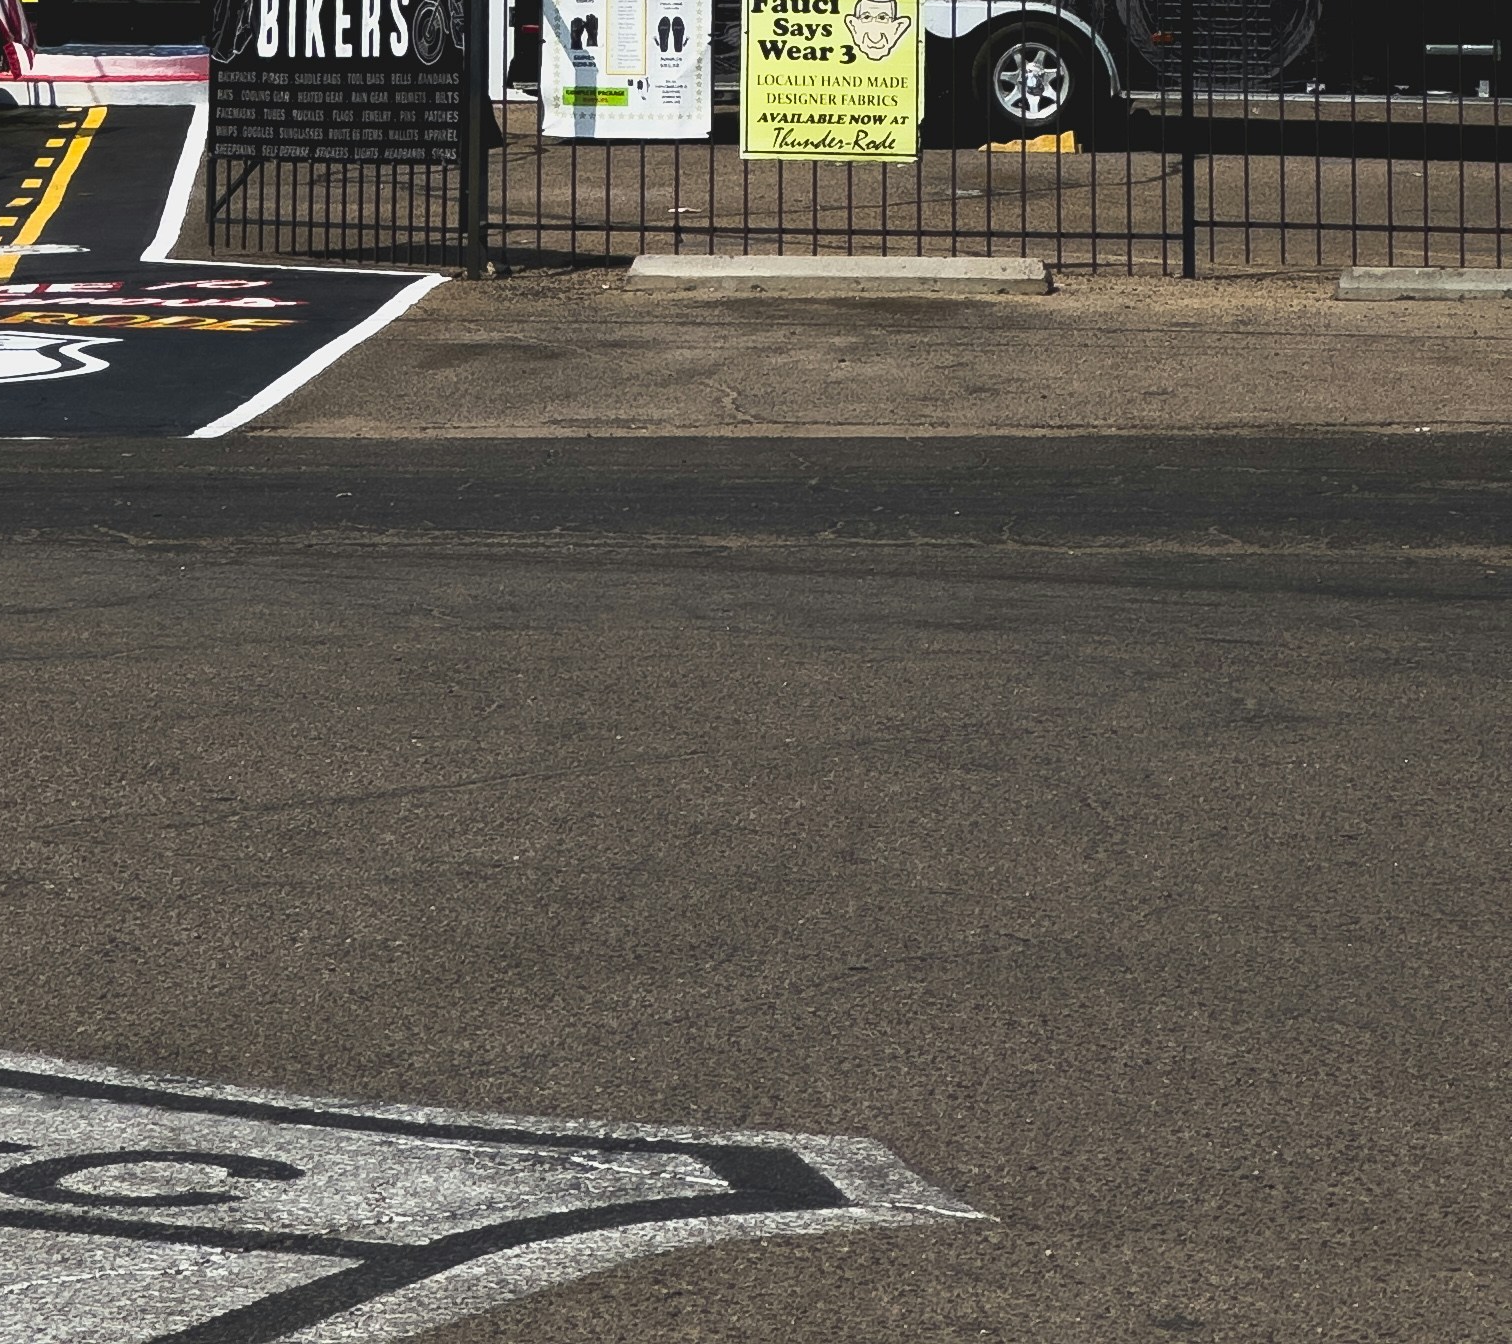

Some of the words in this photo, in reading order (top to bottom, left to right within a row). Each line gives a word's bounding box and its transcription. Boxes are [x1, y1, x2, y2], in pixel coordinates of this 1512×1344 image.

[773, 17, 833, 41] Says
[757, 39, 834, 61] Wear
[839, 45, 857, 64] 3
[757, 74, 817, 88] LOCALLY
[821, 75, 863, 88] HAND
[867, 76, 909, 89] MADE
[767, 93, 837, 106] DESIGNER
[841, 94, 898, 107] FABRICS
[757, 112, 847, 125] AVAILABLE
[848, 114, 887, 125] NOW
[890, 116, 909, 125] AT
[773, 126, 897, 151] Thunder-Rode
